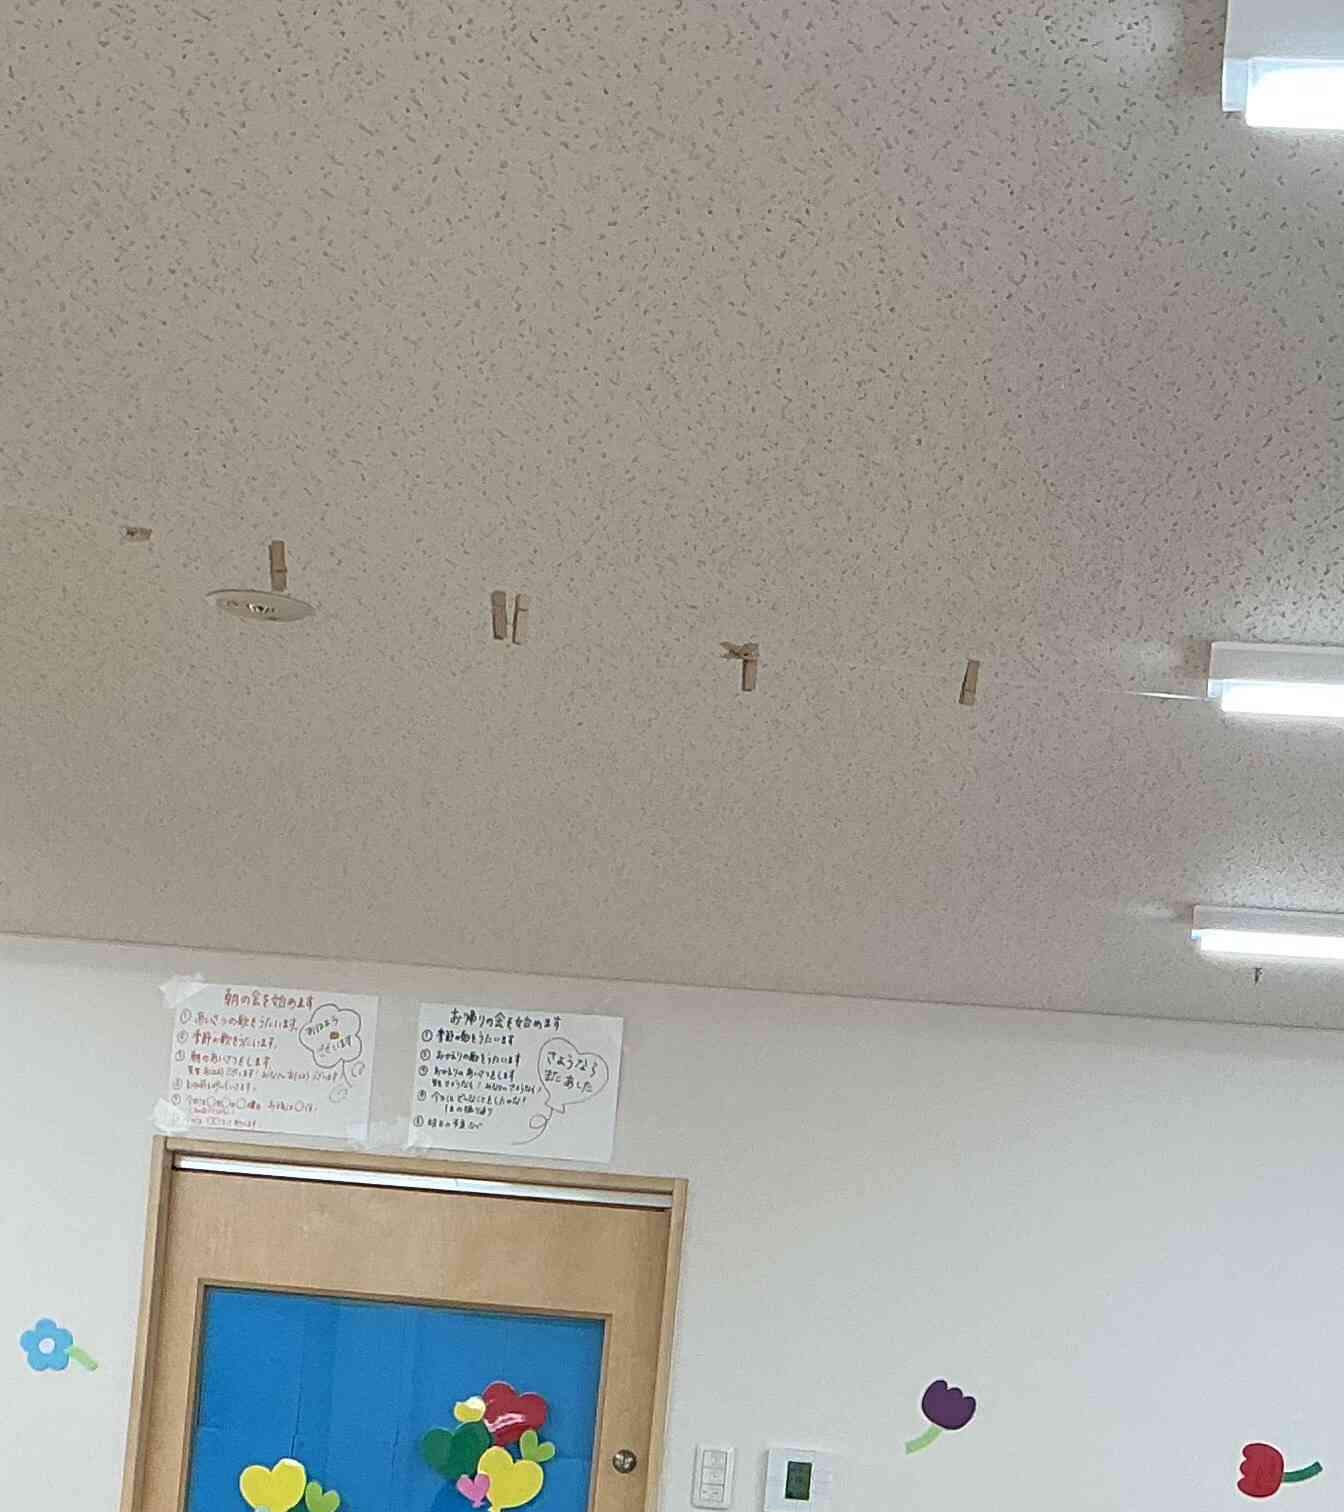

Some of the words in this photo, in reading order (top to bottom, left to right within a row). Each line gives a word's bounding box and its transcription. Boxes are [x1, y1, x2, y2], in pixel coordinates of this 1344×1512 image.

[224, 988, 314, 1011] 朝の会を始めます
[450, 1008, 561, 1031] お帰りの会を始めます
[545, 1051, 598, 1079] さようなら
